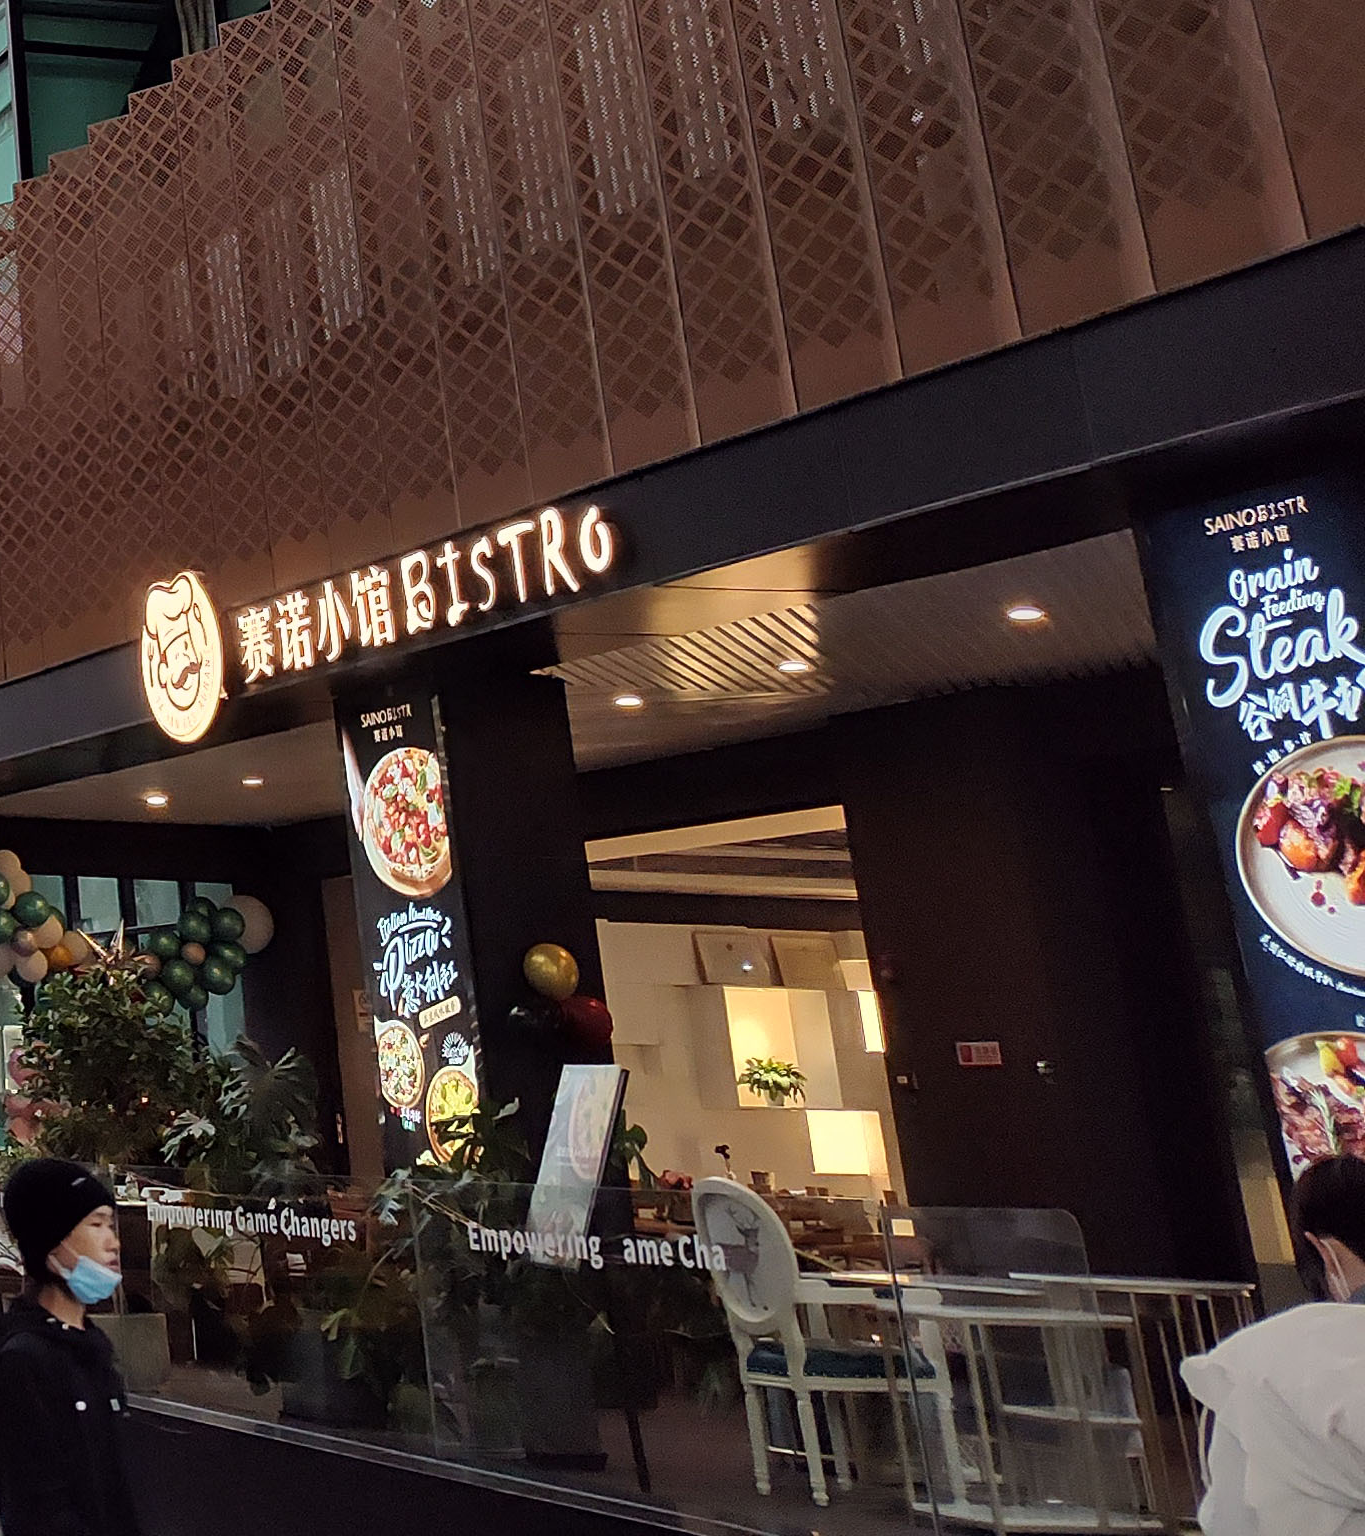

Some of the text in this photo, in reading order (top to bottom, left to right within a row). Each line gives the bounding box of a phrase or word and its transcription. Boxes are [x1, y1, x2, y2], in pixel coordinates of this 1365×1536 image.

[236, 504, 614, 684] 赛诺小馆 BISTRO
[1228, 547, 1319, 608] Grain
[1259, 588, 1326, 621] Feeding
[1198, 587, 1365, 709] Steak
[379, 929, 440, 1012] Pizza
[146, 1199, 357, 1249] Empowering Game Changers
[468, 1224, 604, 1270] Empowering
